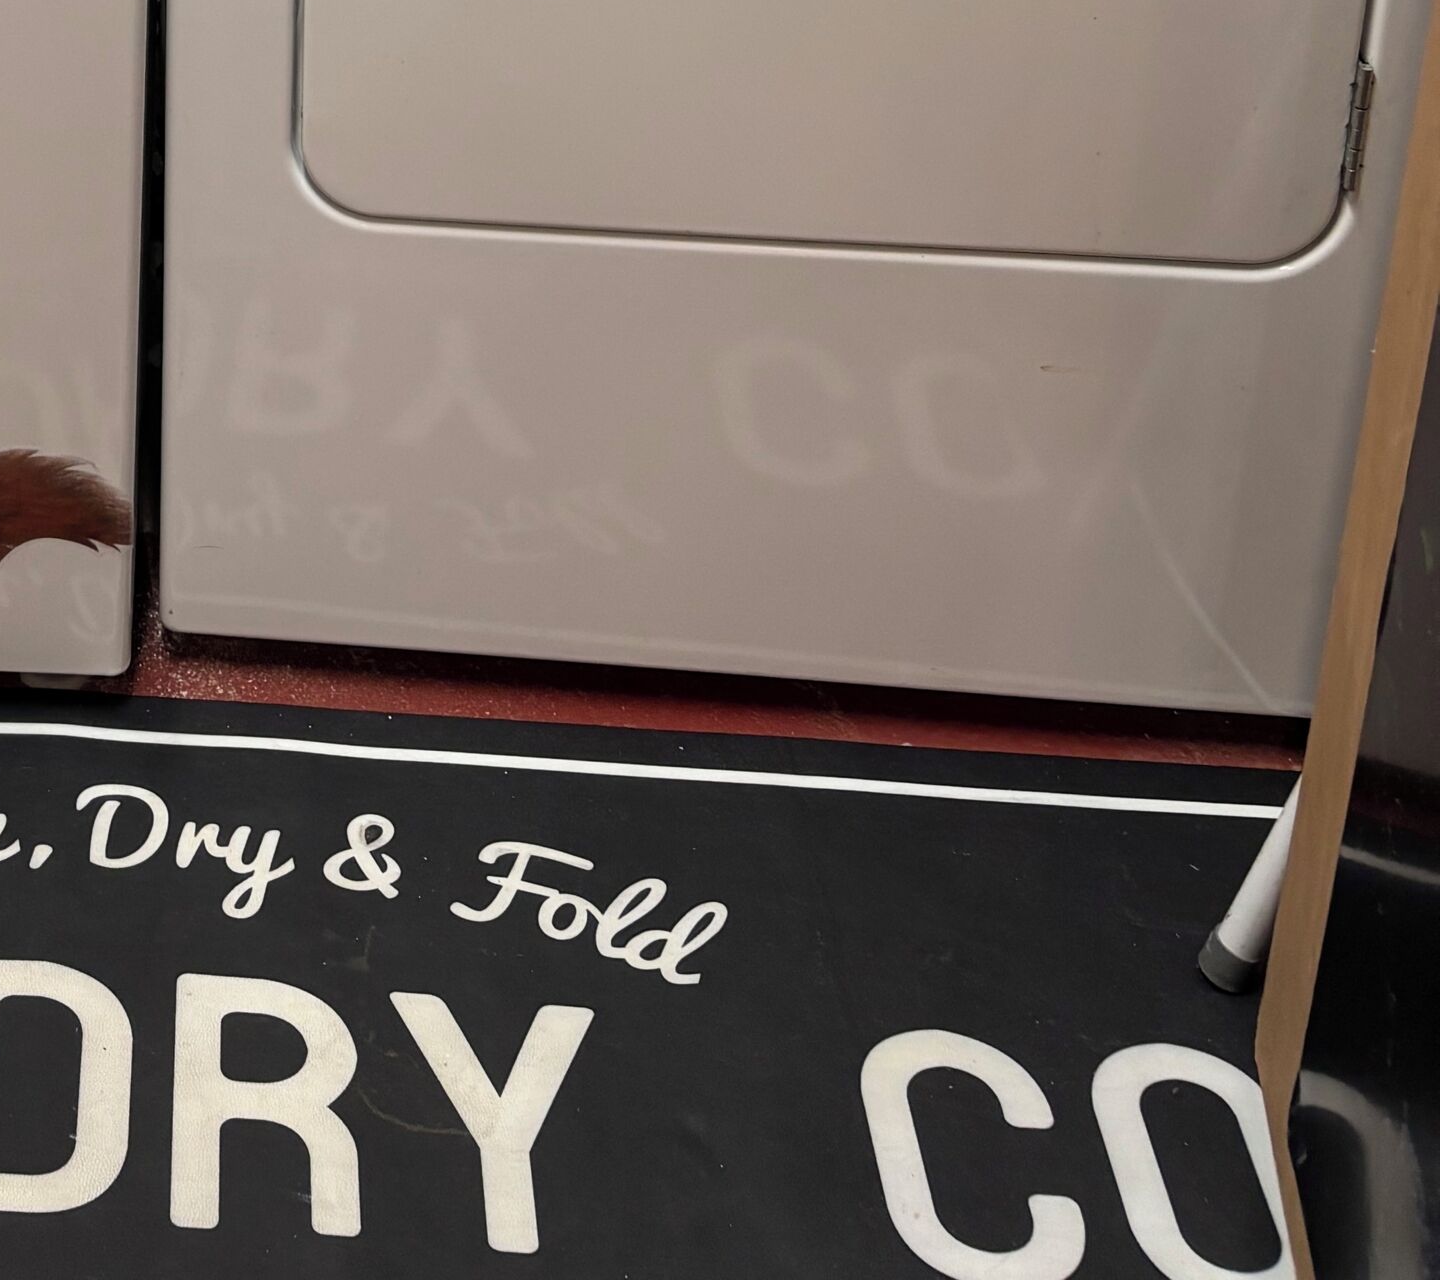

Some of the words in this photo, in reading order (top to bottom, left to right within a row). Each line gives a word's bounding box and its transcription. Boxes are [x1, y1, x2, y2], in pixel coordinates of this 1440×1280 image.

[76, 783, 295, 919] Dry
[321, 812, 401, 900] &
[449, 839, 729, 986] Fold
[861, 1029, 1296, 1280] CO
